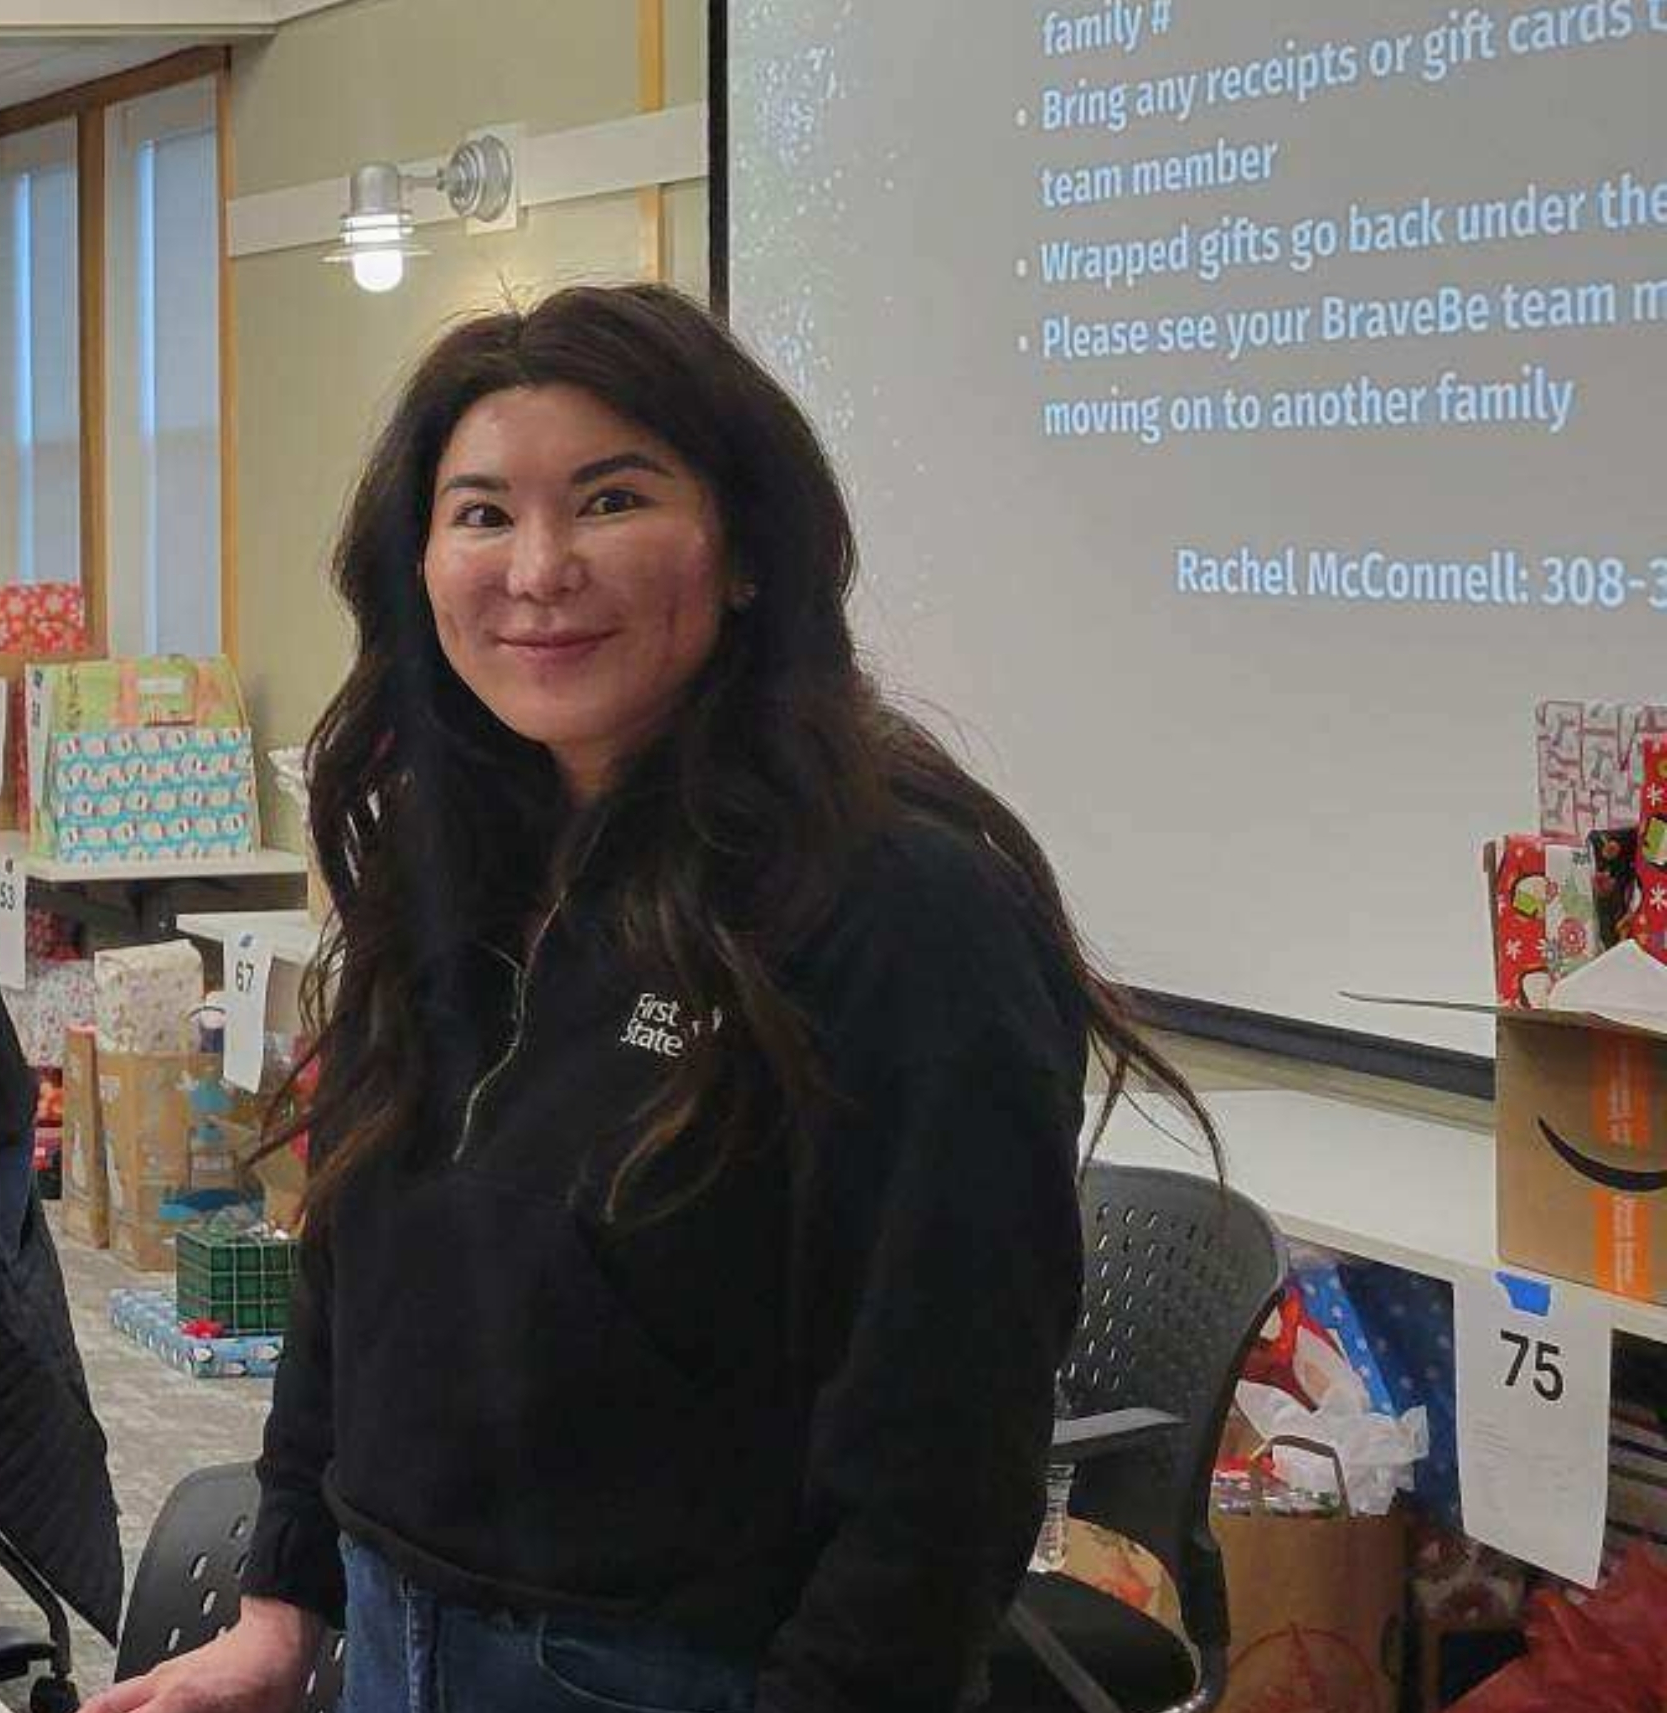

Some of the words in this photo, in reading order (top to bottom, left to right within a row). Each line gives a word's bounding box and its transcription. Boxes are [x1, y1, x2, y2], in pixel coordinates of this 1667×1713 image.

[1042, 0, 1142, 55] family
[1151, 0, 1172, 33] #
[1041, 78, 1128, 132] Bring
[1136, 73, 1197, 121] any
[1205, 38, 1358, 102] receipts
[1369, 34, 1412, 77] or
[1422, 9, 1497, 82] gift
[1507, 0, 1633, 53] cards
[1041, 164, 1122, 207] team
[1131, 137, 1279, 194] member
[1040, 223, 1190, 288] Wrapped
[1199, 216, 1280, 281] gifts
[1289, 219, 1337, 272] go
[1348, 197, 1445, 252] back
[1457, 184, 1586, 243] under
[1597, 172, 1667, 229] the
[1043, 316, 1150, 360] Please
[1157, 314, 1217, 350] see
[1226, 306, 1311, 361] your
[1321, 286, 1490, 341] BraveBe
[1501, 283, 1616, 329] team
[1044, 386, 1161, 444] moving
[1169, 396, 1212, 430] on
[1222, 389, 1261, 430] to
[1271, 376, 1427, 428] another
[1436, 363, 1575, 434] family
[1176, 547, 1297, 598] Rachel
[1307, 549, 1529, 605] McConnell:
[233, 958, 256, 994] 67
[634, 992, 681, 1027] First
[619, 1018, 685, 1058] State
[1499, 1328, 1565, 1403] 75
